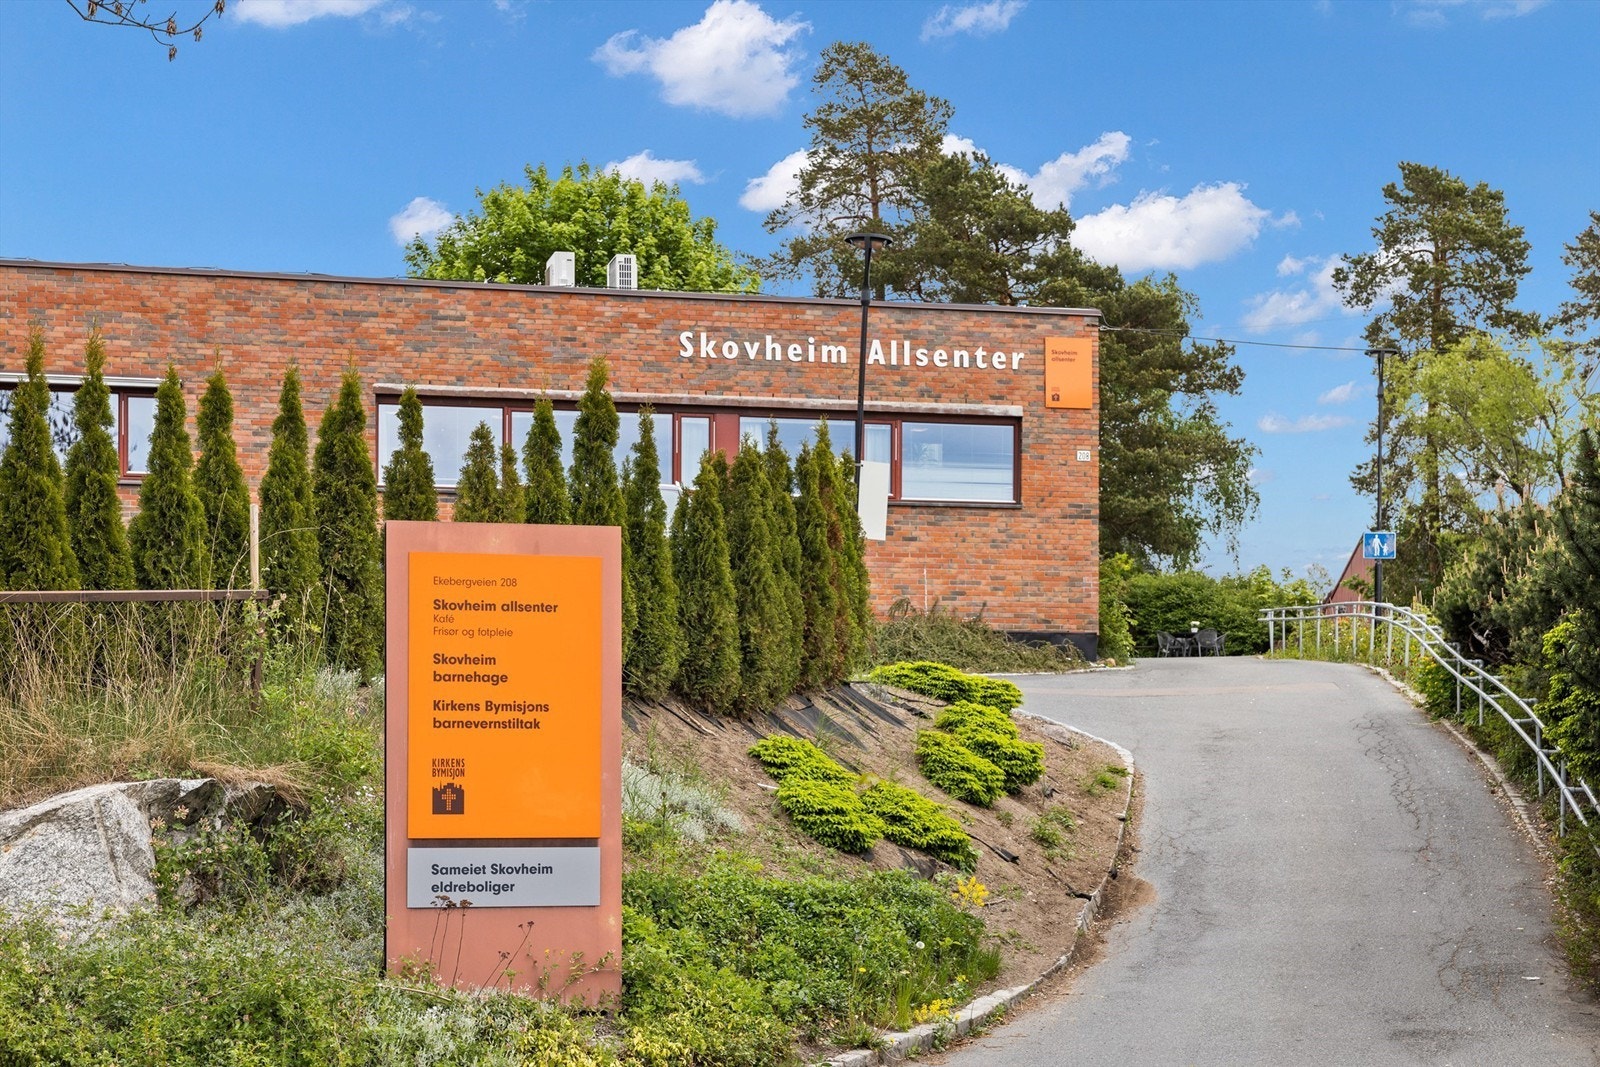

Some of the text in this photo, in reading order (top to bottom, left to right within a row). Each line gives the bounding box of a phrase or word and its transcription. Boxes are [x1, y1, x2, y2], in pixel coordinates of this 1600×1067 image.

[679, 331, 1025, 370] Skovheim Allsenter
[1078, 451, 1090, 460] 208
[433, 576, 518, 588] Ekebergveien 208
[433, 599, 559, 613] Skovheim allsenter
[433, 614, 455, 623] Kafé
[433, 627, 514, 639] Frisør og fotpleie
[433, 653, 497, 665] Skovheim
[433, 671, 509, 686] barnehage
[433, 700, 550, 714] Kirkens Bymisjons
[433, 718, 541, 730] barnevernstiltak
[432, 758, 465, 768] KIRKENS
[432, 768, 465, 780] BYMISJON
[431, 863, 553, 876] Sameiet Skovheim
[431, 881, 515, 895] eldreboliger
